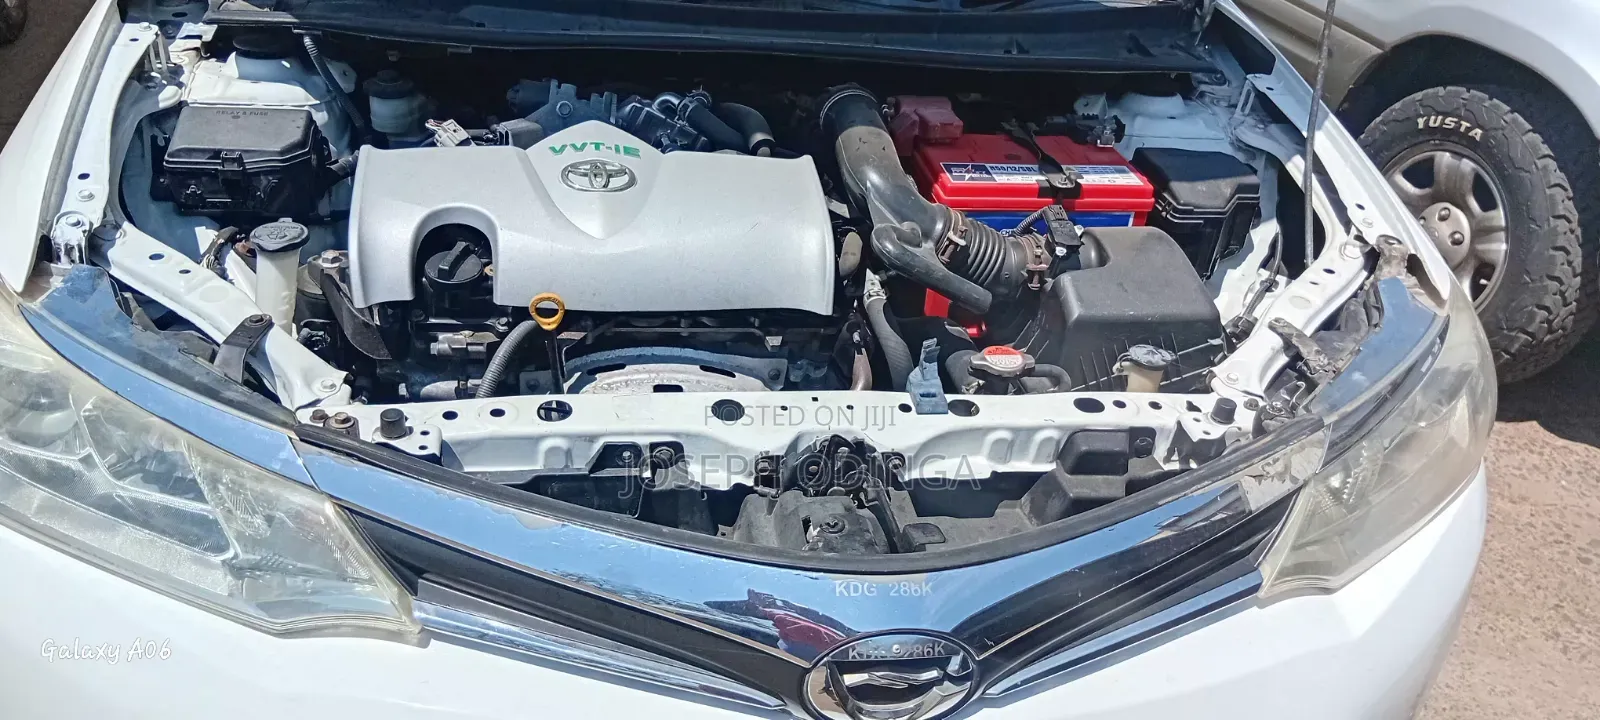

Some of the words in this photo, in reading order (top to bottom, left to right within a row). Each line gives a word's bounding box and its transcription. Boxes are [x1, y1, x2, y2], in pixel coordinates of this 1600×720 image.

[1417, 115, 1483, 142] YUSTA
[835, 580, 877, 597] KDG
[889, 581, 933, 597] 286K
